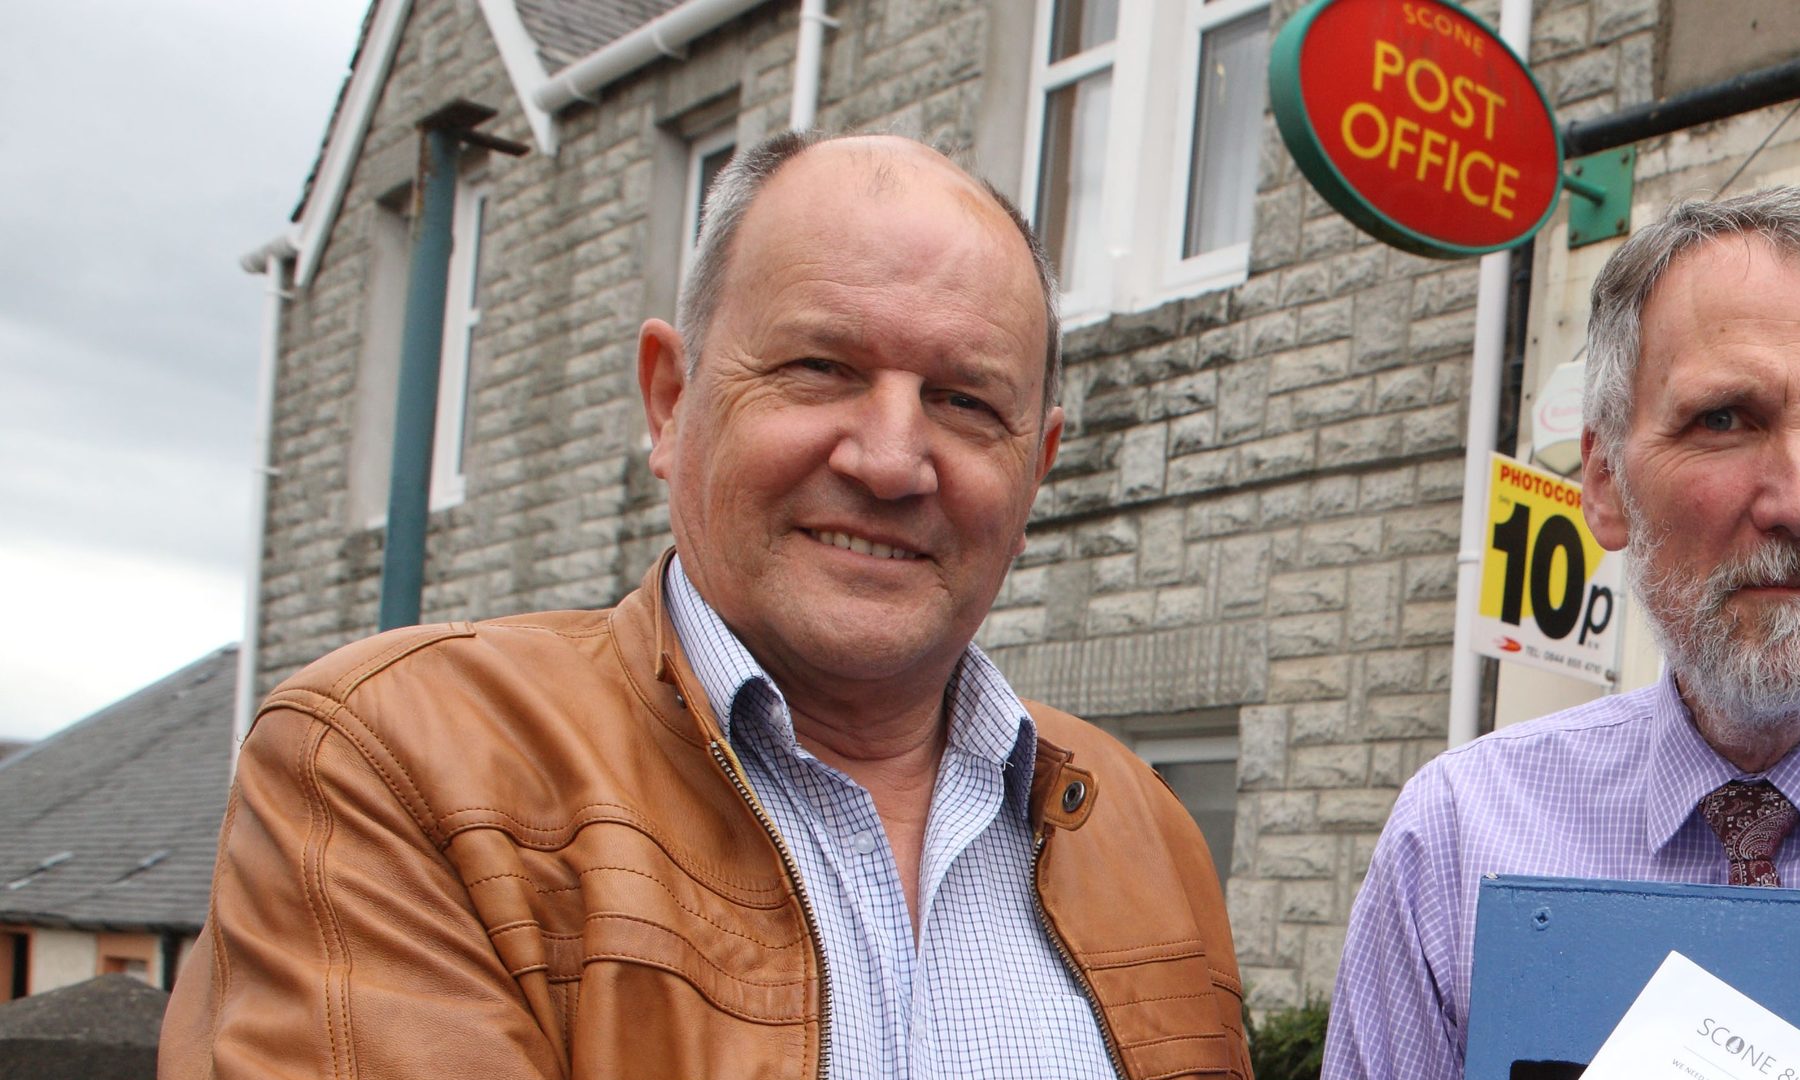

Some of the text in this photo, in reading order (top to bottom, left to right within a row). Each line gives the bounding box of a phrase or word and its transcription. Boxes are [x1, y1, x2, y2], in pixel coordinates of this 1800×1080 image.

[1402, 2, 1486, 58] SCONE
[1373, 39, 1506, 140] POST
[1341, 102, 1520, 220] OFFICE
[1492, 502, 1613, 645] 10p
[1672, 1058, 1684, 1070] WE
[1696, 1018, 1777, 1075] SCONE
